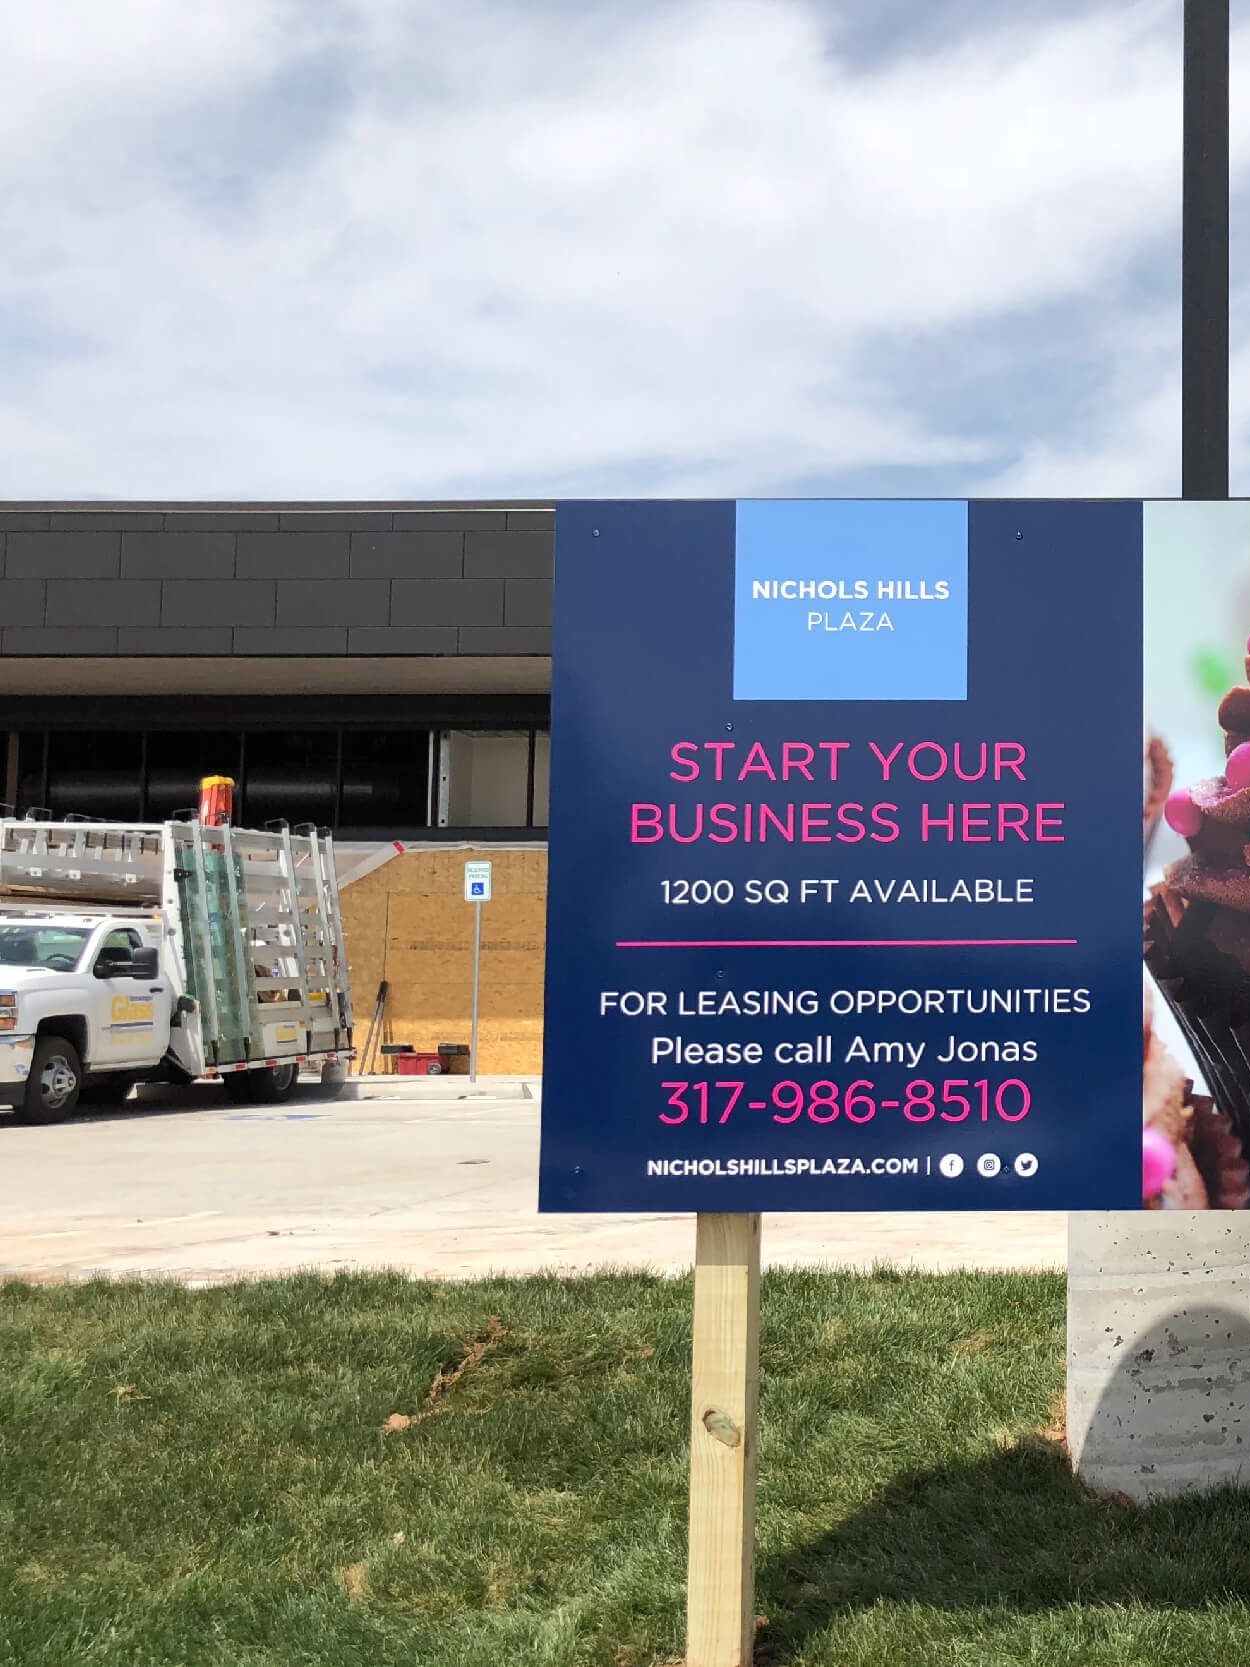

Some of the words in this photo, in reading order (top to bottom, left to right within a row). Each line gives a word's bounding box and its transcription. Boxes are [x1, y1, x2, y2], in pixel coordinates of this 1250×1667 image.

[752, 580, 869, 600] NICHOLS
[877, 580, 950, 600] HILLS
[807, 611, 895, 632] PLAZA
[670, 741, 851, 782] START
[868, 741, 1027, 781] YOUR
[630, 803, 900, 843] BUSINESS
[921, 803, 1065, 842] HERE
[660, 879, 734, 905] 1200
[744, 879, 789, 904] SQ
[800, 879, 840, 903] FT
[849, 879, 1034, 903] AVAILABLE
[600, 991, 668, 1016] FOR
[678, 990, 819, 1016] LEASING
[830, 988, 1091, 1015] OPPORTUNITIES
[651, 1036, 763, 1065] Please
[774, 1035, 832, 1064] call
[844, 1035, 926, 1068] Amy
[937, 1035, 1038, 1063] Jonas
[658, 1078, 1031, 1125] 317-986-8510
[647, 1157, 919, 1176] NICHOLSHILLSPLAZA.COM
